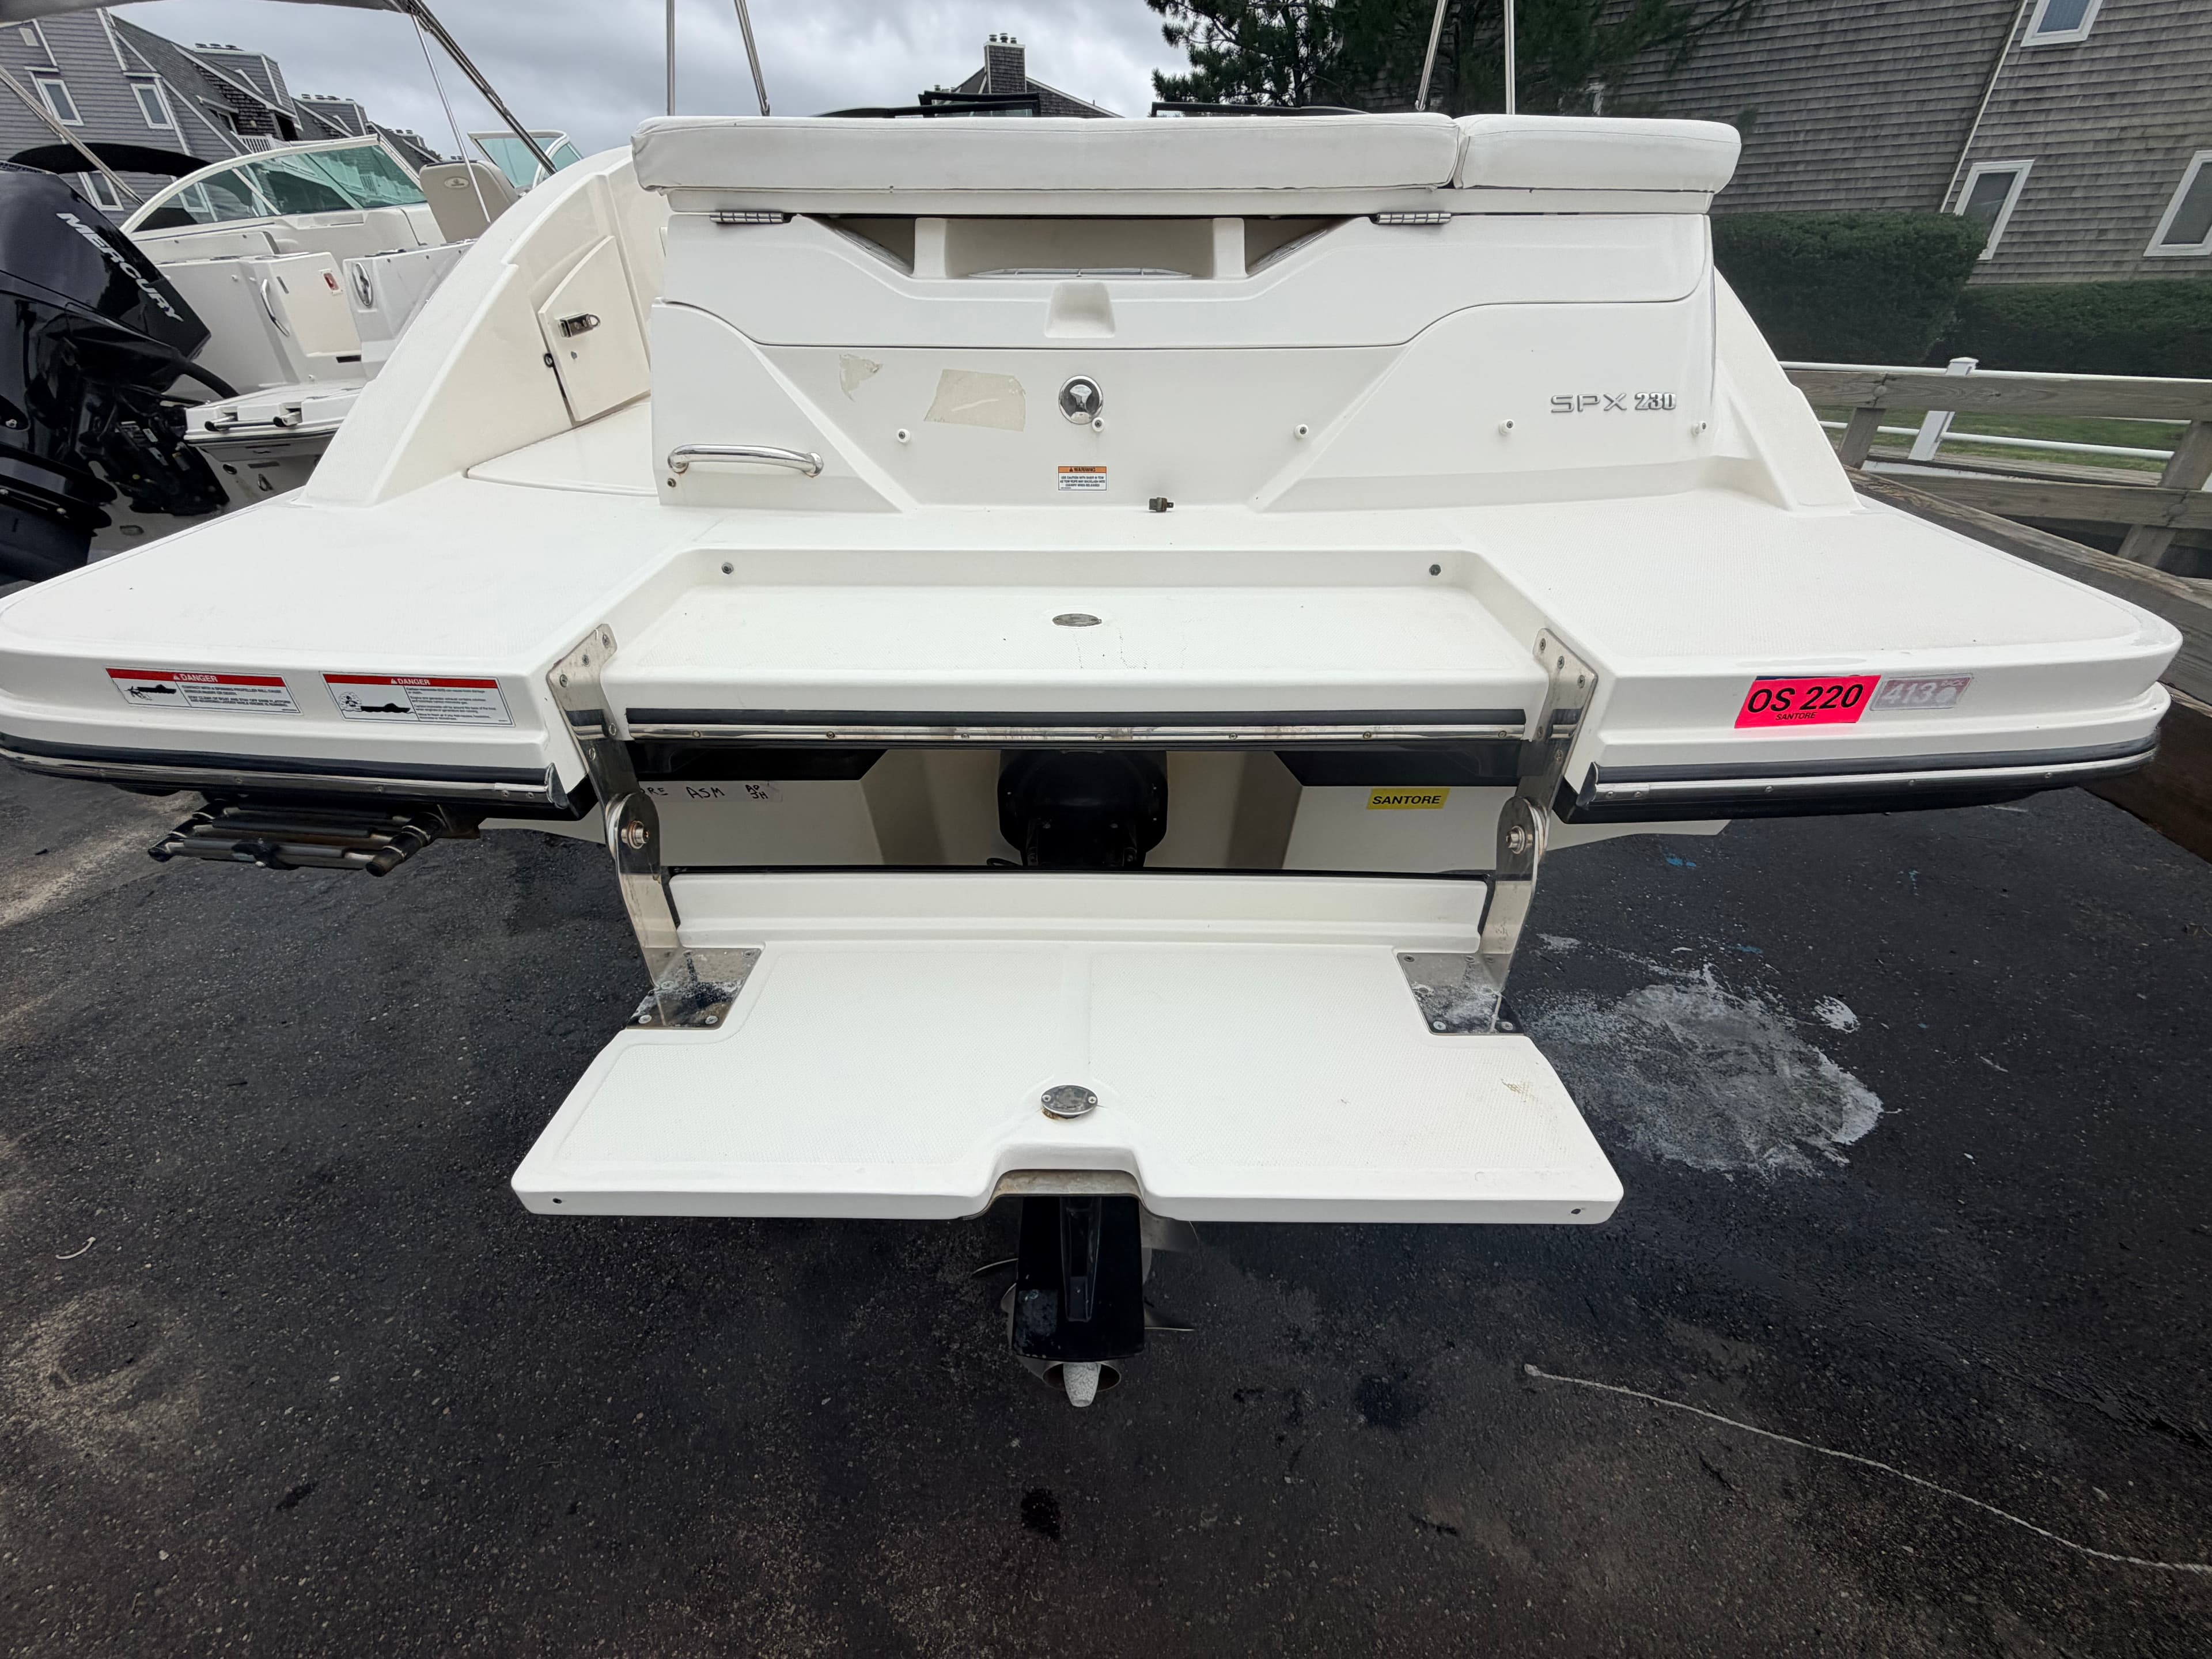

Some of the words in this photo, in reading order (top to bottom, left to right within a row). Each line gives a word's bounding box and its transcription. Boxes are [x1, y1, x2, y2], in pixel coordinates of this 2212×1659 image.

[56, 213, 184, 322] MERCURY
[1551, 393, 1627, 413] SPX
[1634, 392, 1677, 411] 230
[180, 673, 218, 682] DANGER
[1748, 687, 1796, 713] OS
[1799, 684, 1863, 710] 220
[1775, 711, 1817, 721] SANTORE
[685, 786, 725, 799] ASM
[1372, 795, 1442, 805] SANTORE
